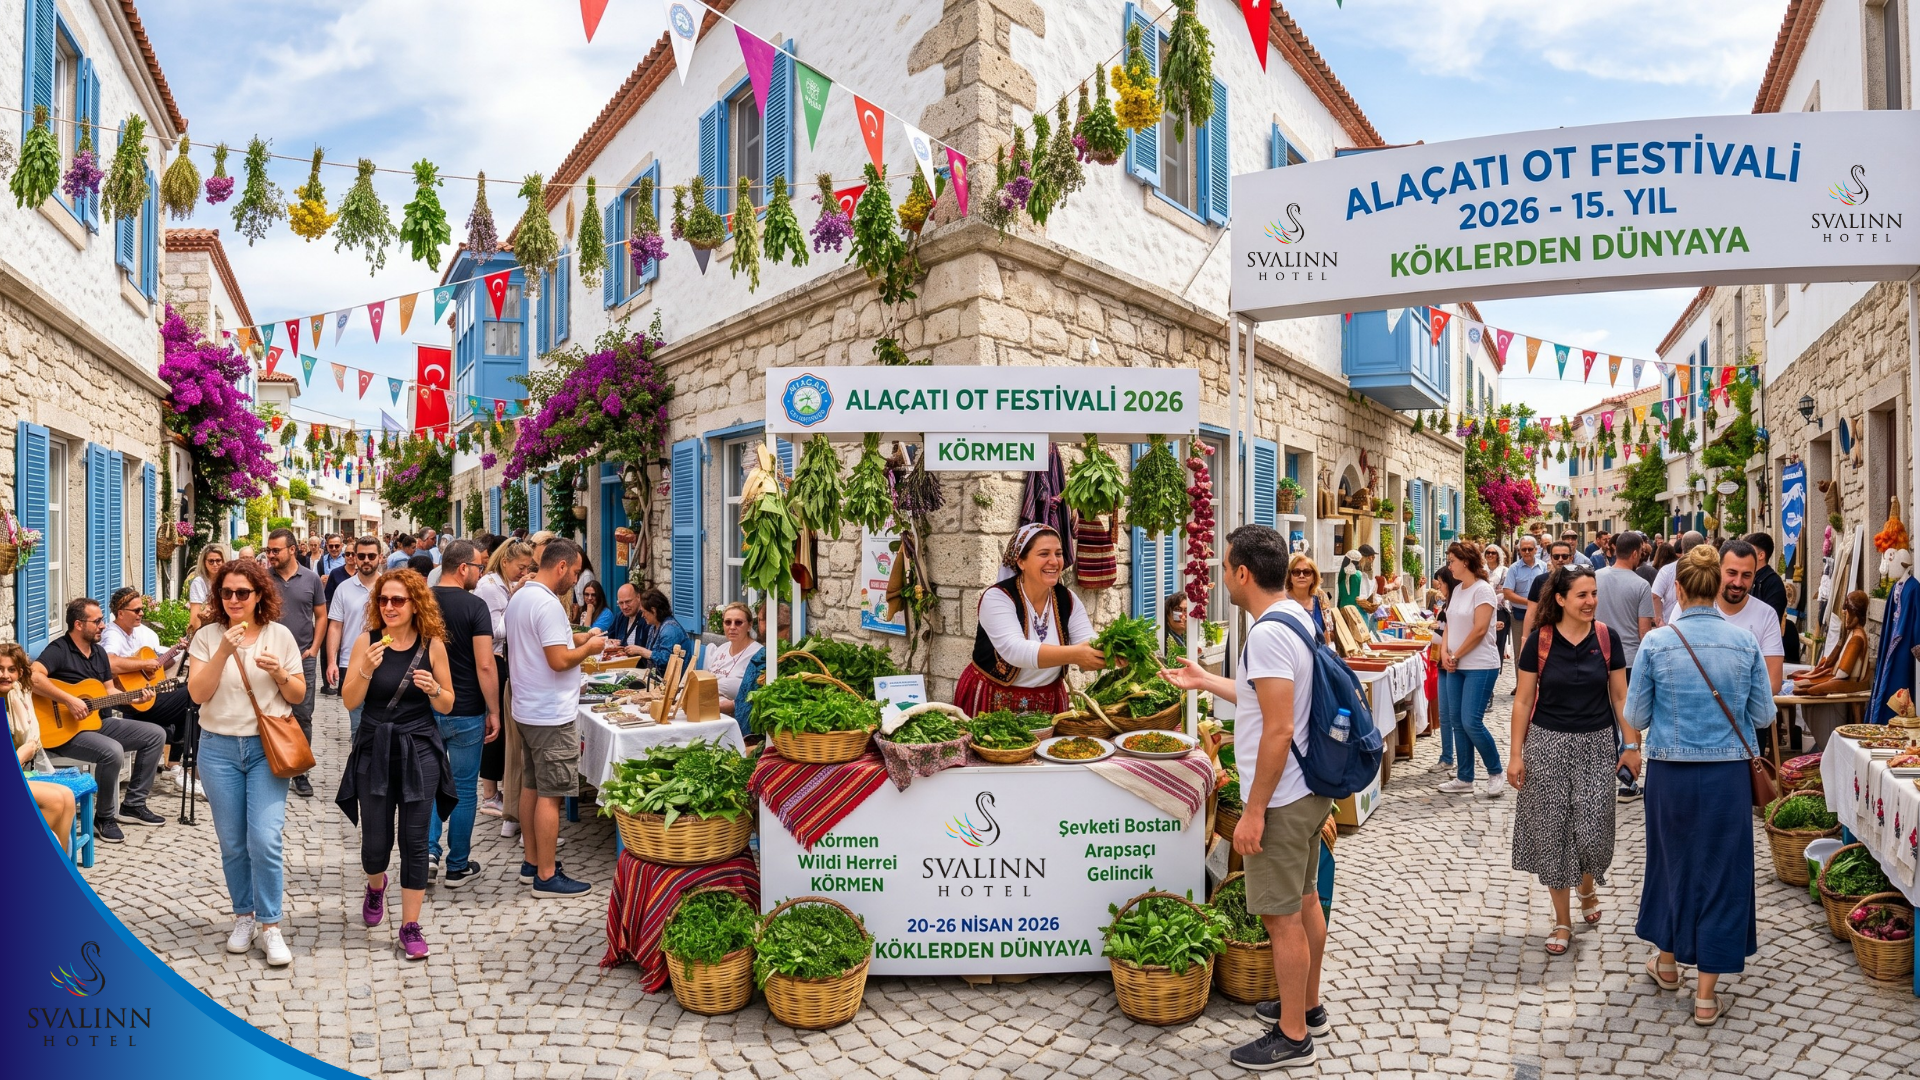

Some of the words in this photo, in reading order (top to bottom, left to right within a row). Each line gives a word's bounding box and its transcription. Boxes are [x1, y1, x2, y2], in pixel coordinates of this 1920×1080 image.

[1346, 154, 1509, 221] ALAÇATI
[1522, 146, 1577, 182] OT
[1591, 133, 1802, 183] FESTİVALİ
[1459, 196, 1540, 231] 2026
[1571, 190, 1614, 220] 15.
[1623, 186, 1678, 216] YIL
[1812, 212, 1903, 229] SVALINN
[1823, 233, 1892, 243] HOTEL
[1247, 251, 1338, 268] SVALINN
[1390, 235, 1581, 278] KÖKLERDEN
[1592, 225, 1750, 261] DÜNYAYA
[1258, 271, 1328, 282] HOTEL
[845, 388, 948, 415] ALAÇATI
[955, 388, 989, 411] OT
[996, 384, 1116, 412] FESTİVALİ
[1123, 390, 1184, 413] 2026
[938, 437, 1035, 462] KÖRMEN
[1058, 817, 1120, 838] Şevketi
[1124, 817, 1181, 833] Bostan
[1084, 843, 1156, 861] Arapsaçı
[797, 854, 841, 870] Wildi
[846, 854, 897, 870] Herrei
[922, 857, 1046, 879] SVALINN
[1087, 864, 1154, 882] Gelincik
[811, 873, 884, 892] KÖRMEN
[938, 885, 1032, 897] HOTEL
[907, 917, 957, 933] 20-26
[961, 915, 1013, 932] NİSAN
[1017, 916, 1060, 932] 2026
[875, 938, 994, 959] KÖKLERDEN
[1000, 937, 1093, 958] DÜNYAYA
